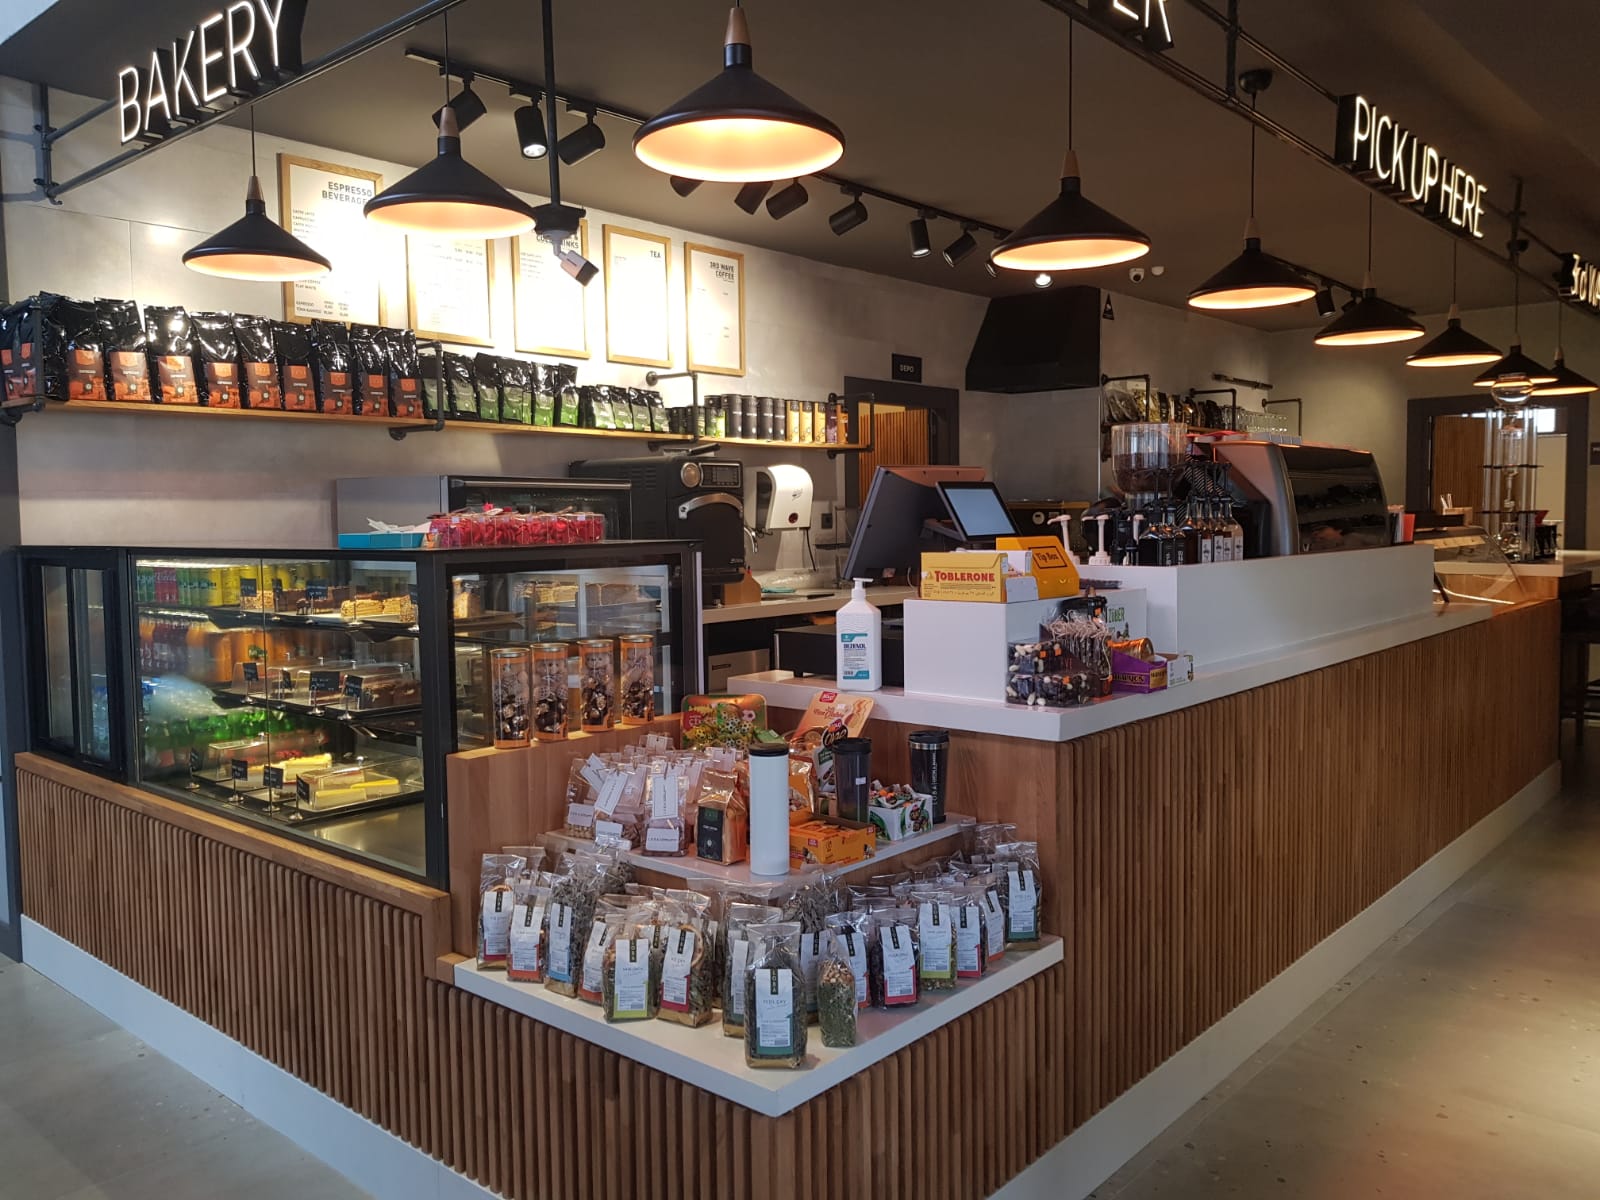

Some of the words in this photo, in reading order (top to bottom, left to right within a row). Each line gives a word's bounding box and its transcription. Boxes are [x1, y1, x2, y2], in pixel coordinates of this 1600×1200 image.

[118, 0, 284, 143] BAKERY
[1353, 96, 1408, 191] PICK
[1411, 138, 1439, 203] UP
[1441, 159, 1488, 237] HERE
[328, 181, 373, 197] ESPRESSO
[650, 250, 661, 258] TEA
[715, 270, 735, 280] COFFEE
[934, 570, 995, 583] TOBLERONE
